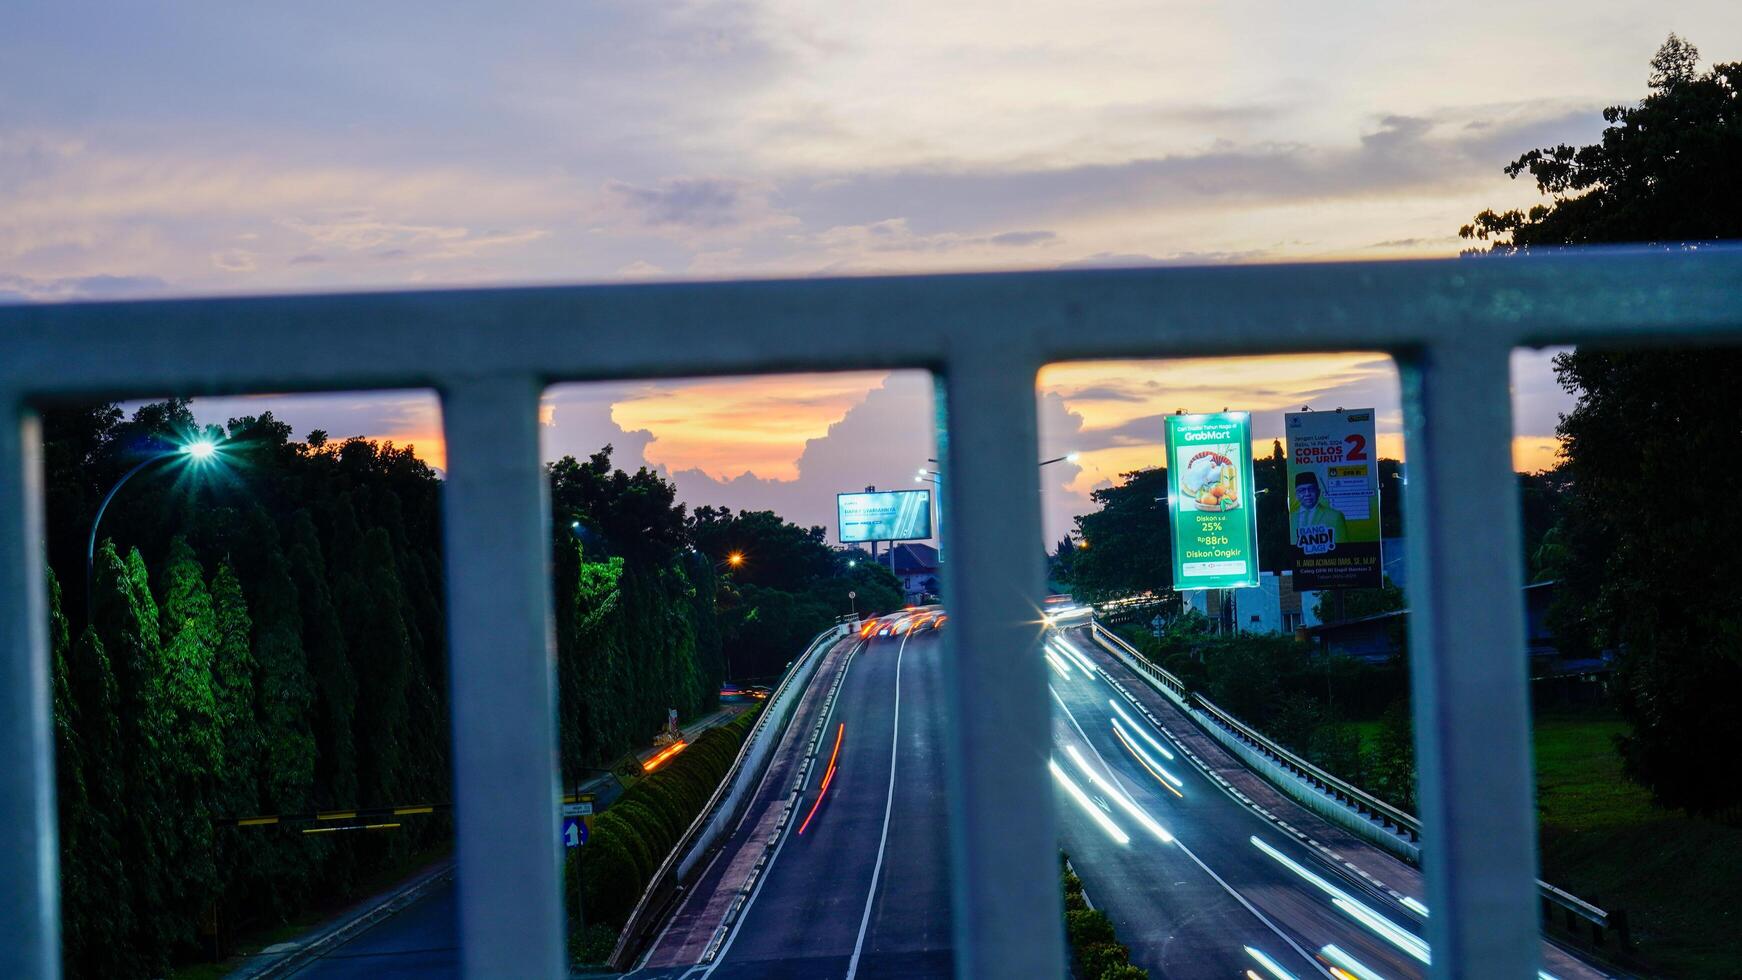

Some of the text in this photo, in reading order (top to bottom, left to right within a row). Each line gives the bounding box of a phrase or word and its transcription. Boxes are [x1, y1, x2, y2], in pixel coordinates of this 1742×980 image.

[1184, 431, 1230, 441] GrabMart
[1295, 446, 1342, 456] COBLOS
[1344, 434, 1367, 461] 2
[1316, 455, 1343, 463] URUT
[1202, 523, 1222, 531] 25%
[1299, 526, 1325, 534] BANG
[1186, 549, 1241, 558] Diskon Ongkir
